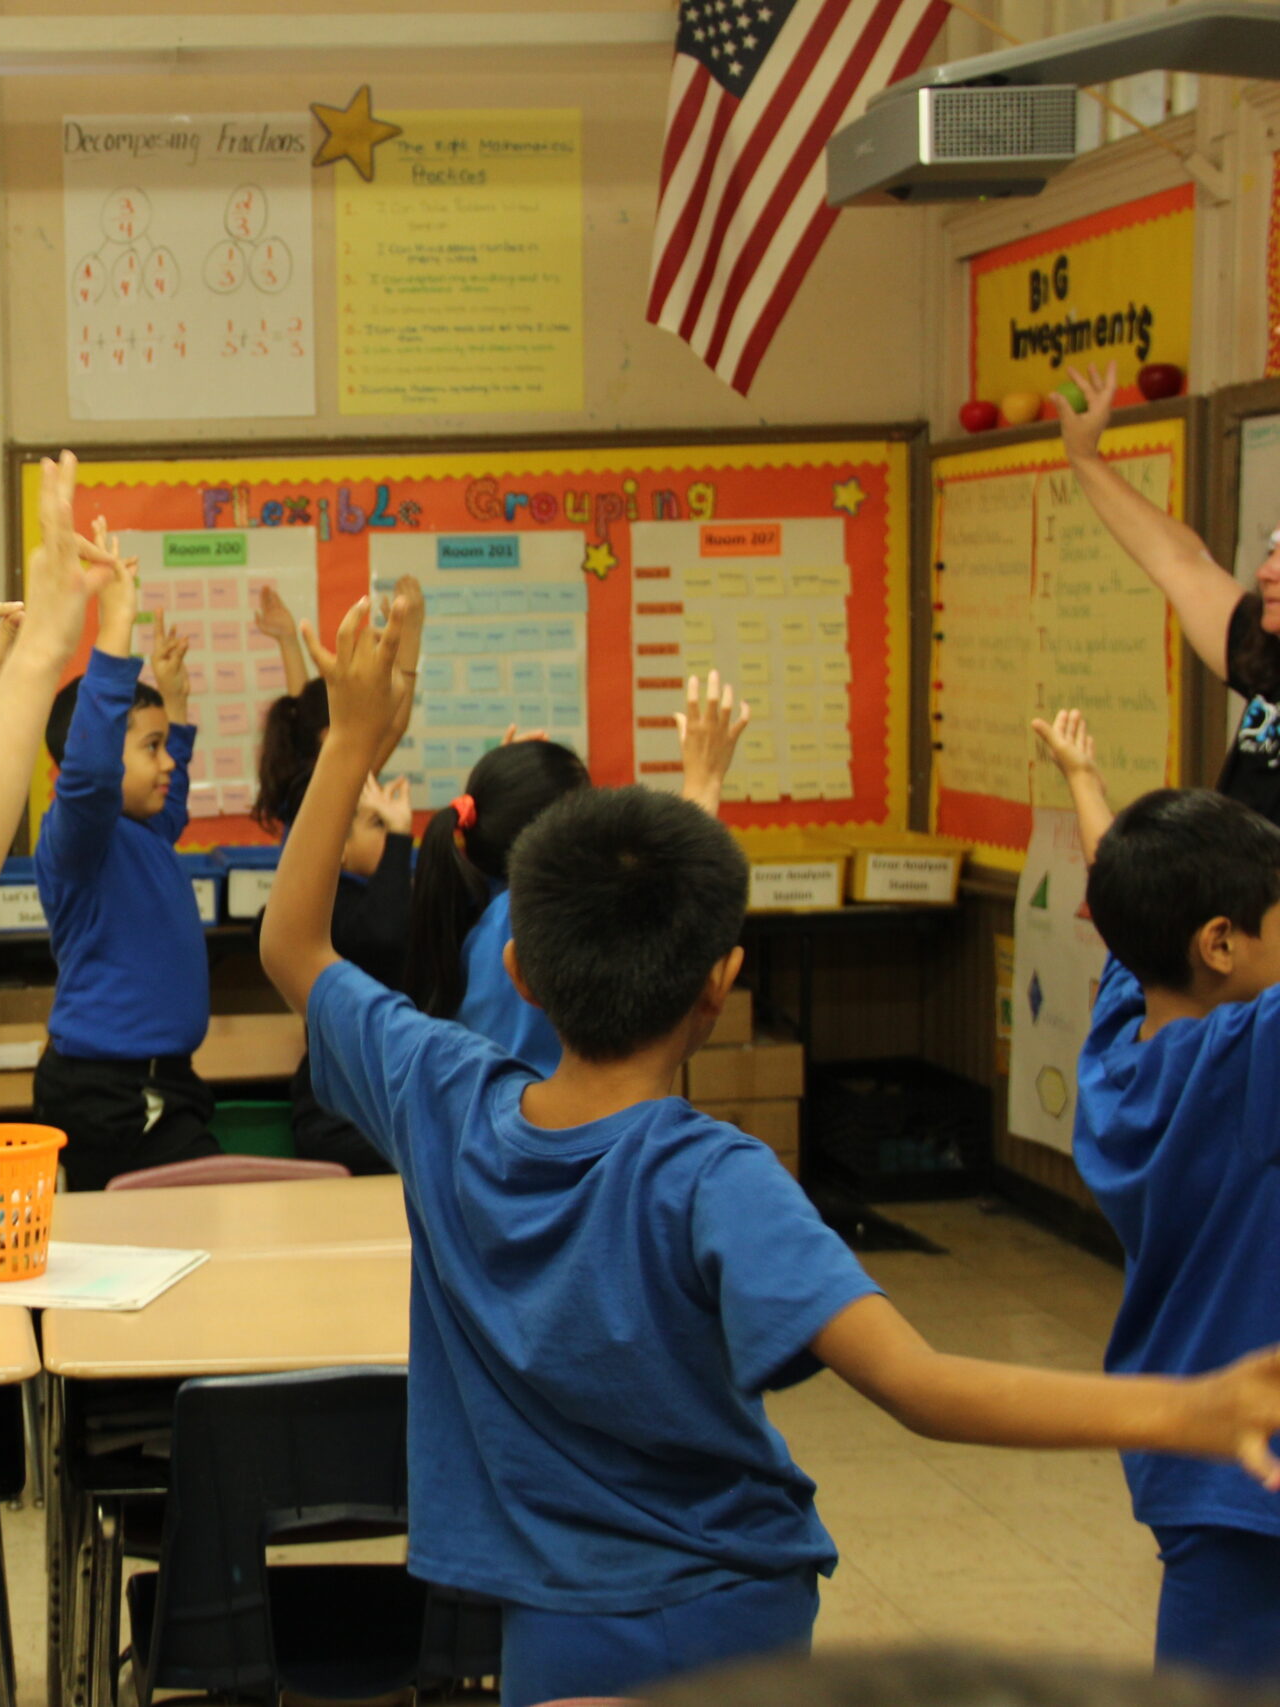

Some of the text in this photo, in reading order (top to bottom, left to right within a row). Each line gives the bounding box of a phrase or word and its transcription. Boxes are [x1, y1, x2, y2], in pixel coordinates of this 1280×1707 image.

[64, 122, 306, 167] Decomposing Fractions
[465, 477, 716, 540] Grouping
[168, 541, 241, 555] Room 200
[442, 543, 513, 559] Room 201
